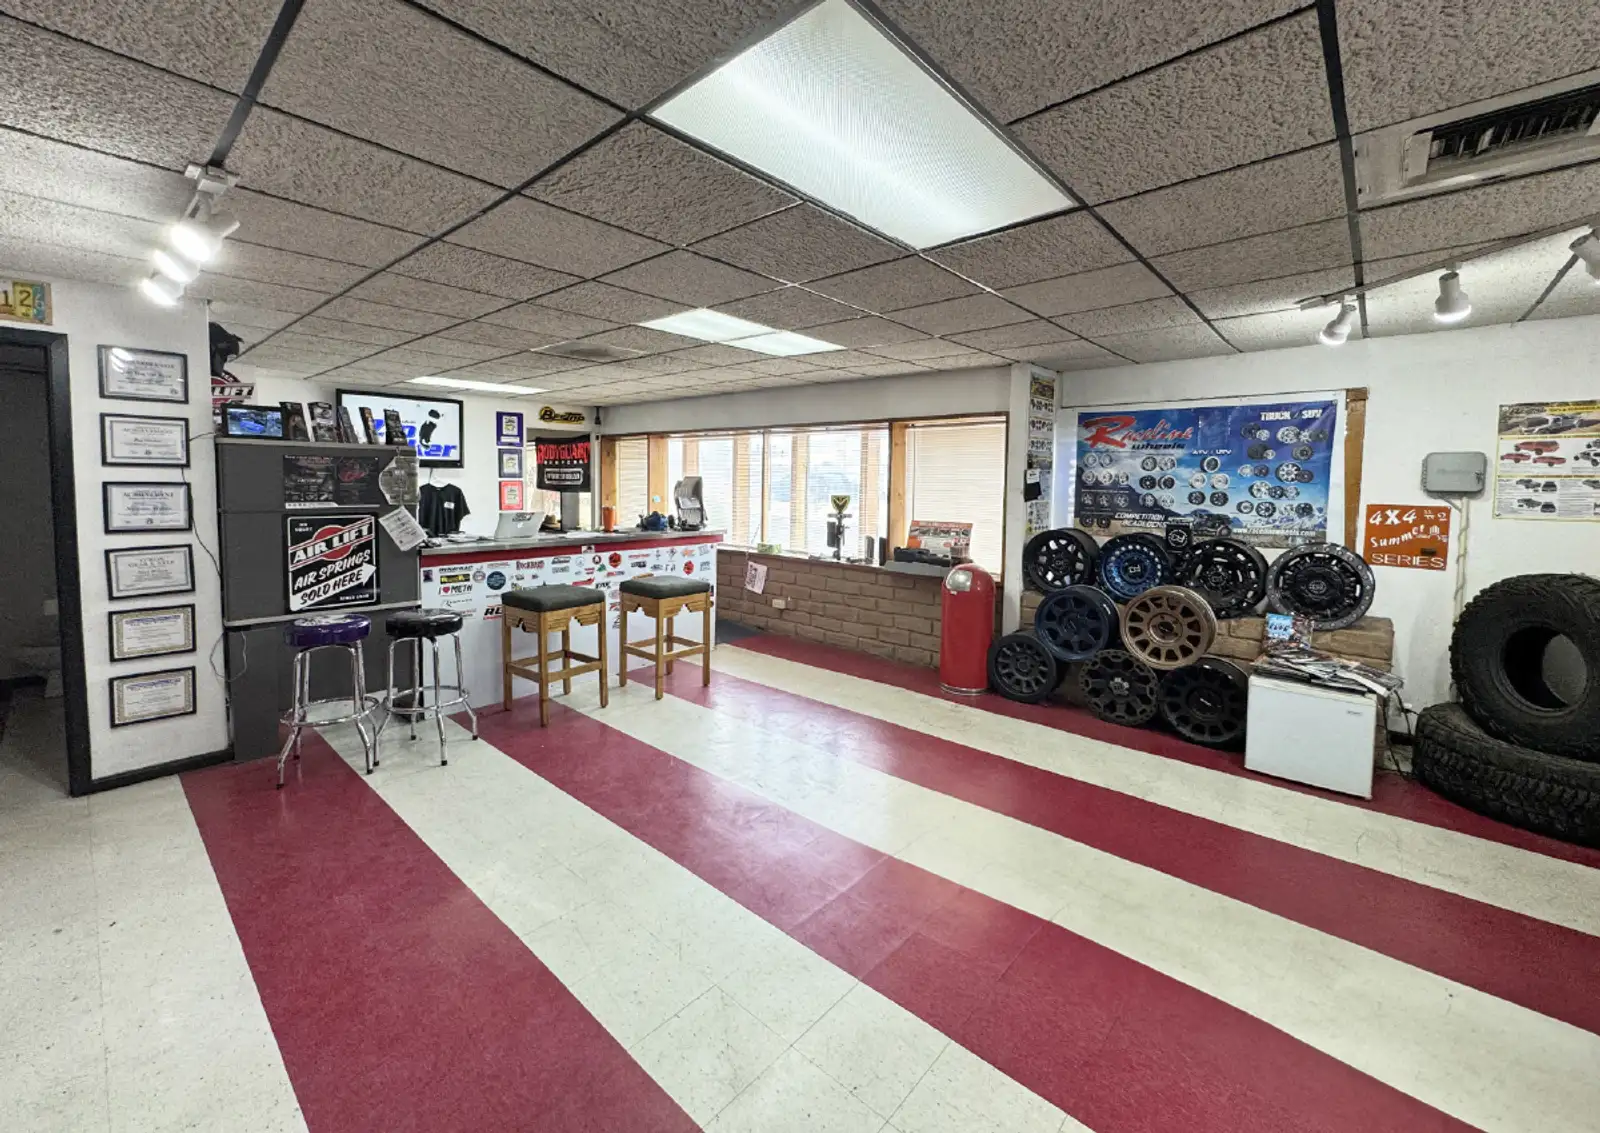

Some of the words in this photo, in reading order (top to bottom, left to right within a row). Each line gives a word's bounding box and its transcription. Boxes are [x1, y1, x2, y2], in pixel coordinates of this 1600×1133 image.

[213, 386, 252, 396] LIFT
[1261, 411, 1291, 420] TRUCK
[1302, 409, 1322, 419] SUV
[1114, 512, 1165, 521] COMPETITION
[293, 542, 328, 563] AIR
[332, 524, 370, 547] LIFT
[1371, 553, 1444, 568] SERIES
[294, 571, 317, 590] AIR
[318, 549, 371, 580] SPRINGS
[300, 583, 330, 605] SOLD
[333, 569, 363, 591] HERE
